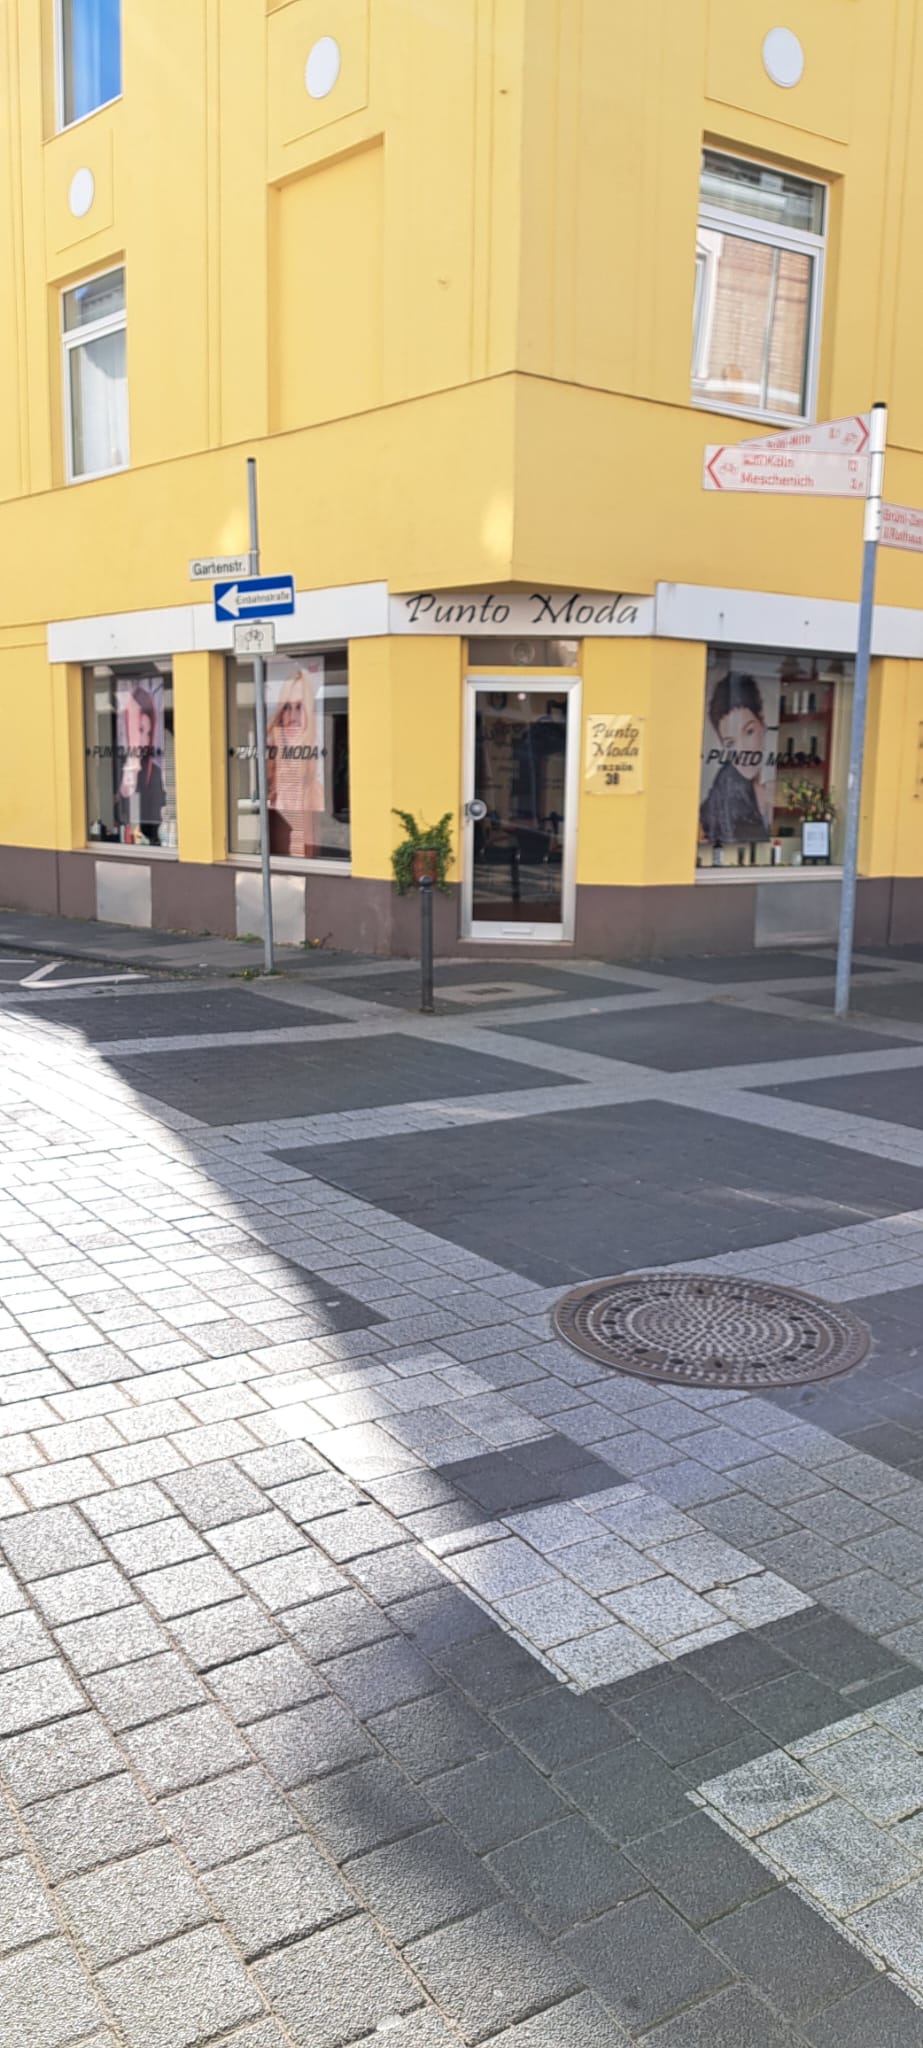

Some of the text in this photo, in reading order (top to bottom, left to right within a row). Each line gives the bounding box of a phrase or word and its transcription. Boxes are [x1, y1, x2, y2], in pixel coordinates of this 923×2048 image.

[741, 472, 814, 487] Meschenich
[192, 560, 246, 576] Gartenstr.
[235, 590, 290, 606] Einbahnstraße
[404, 592, 639, 624] Punto Moda
[592, 722, 640, 739] Punto
[281, 745, 319, 760] MODA
[592, 738, 639, 757] Moda
[705, 749, 763, 766] PUNTO
